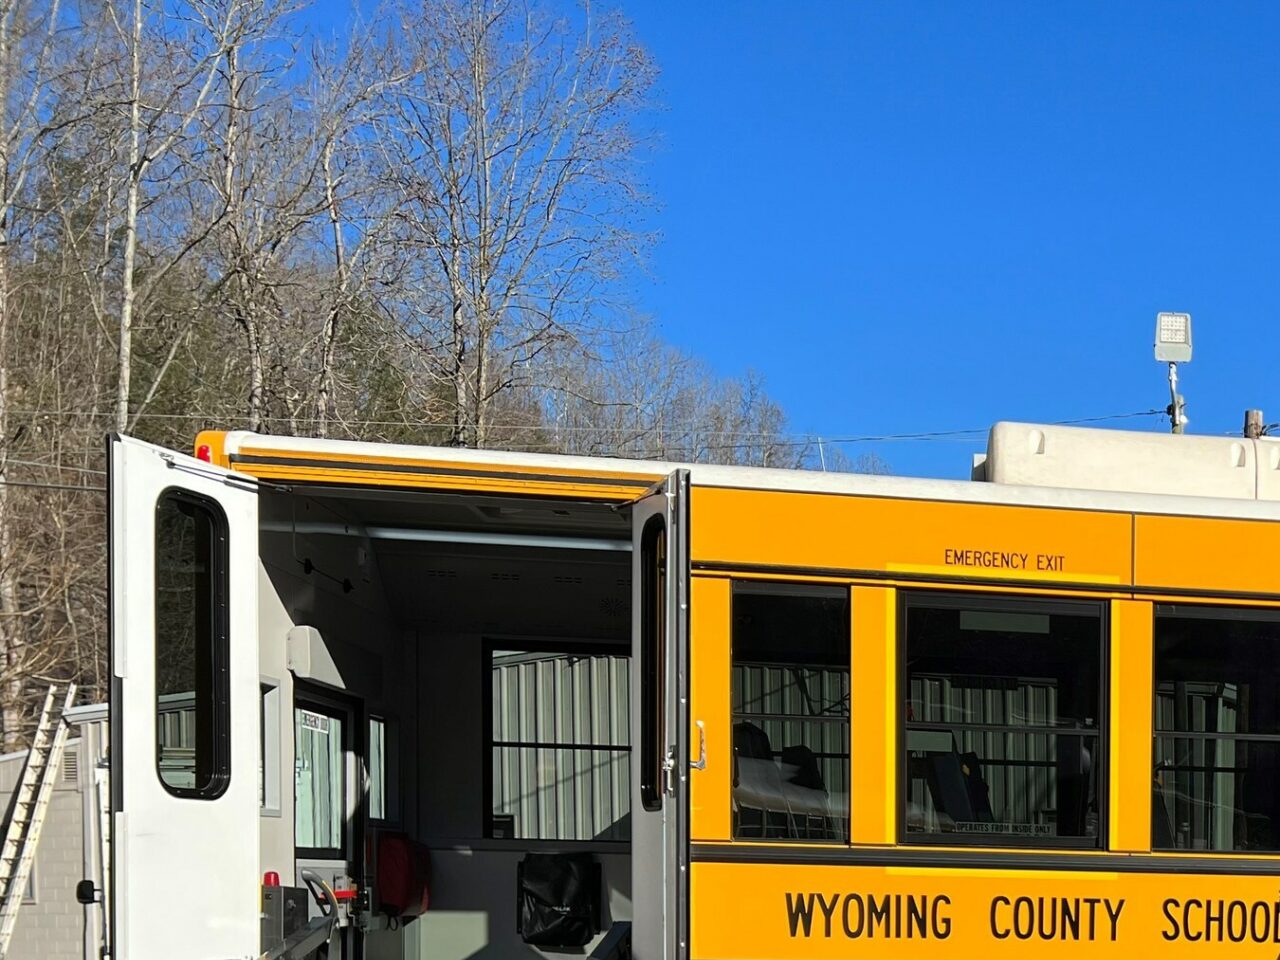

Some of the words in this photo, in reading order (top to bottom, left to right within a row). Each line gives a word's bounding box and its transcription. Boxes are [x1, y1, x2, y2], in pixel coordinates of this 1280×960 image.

[945, 549, 1028, 569] EMERGENCY
[1036, 555, 1065, 571] EXIT
[957, 822, 989, 832] OPERATES
[991, 823, 1010, 833] FROM
[1011, 824, 1032, 834] INSIDE
[1034, 825, 1051, 834] ONLY
[785, 892, 952, 940] WYOMING
[989, 895, 1125, 942] COUNTY
